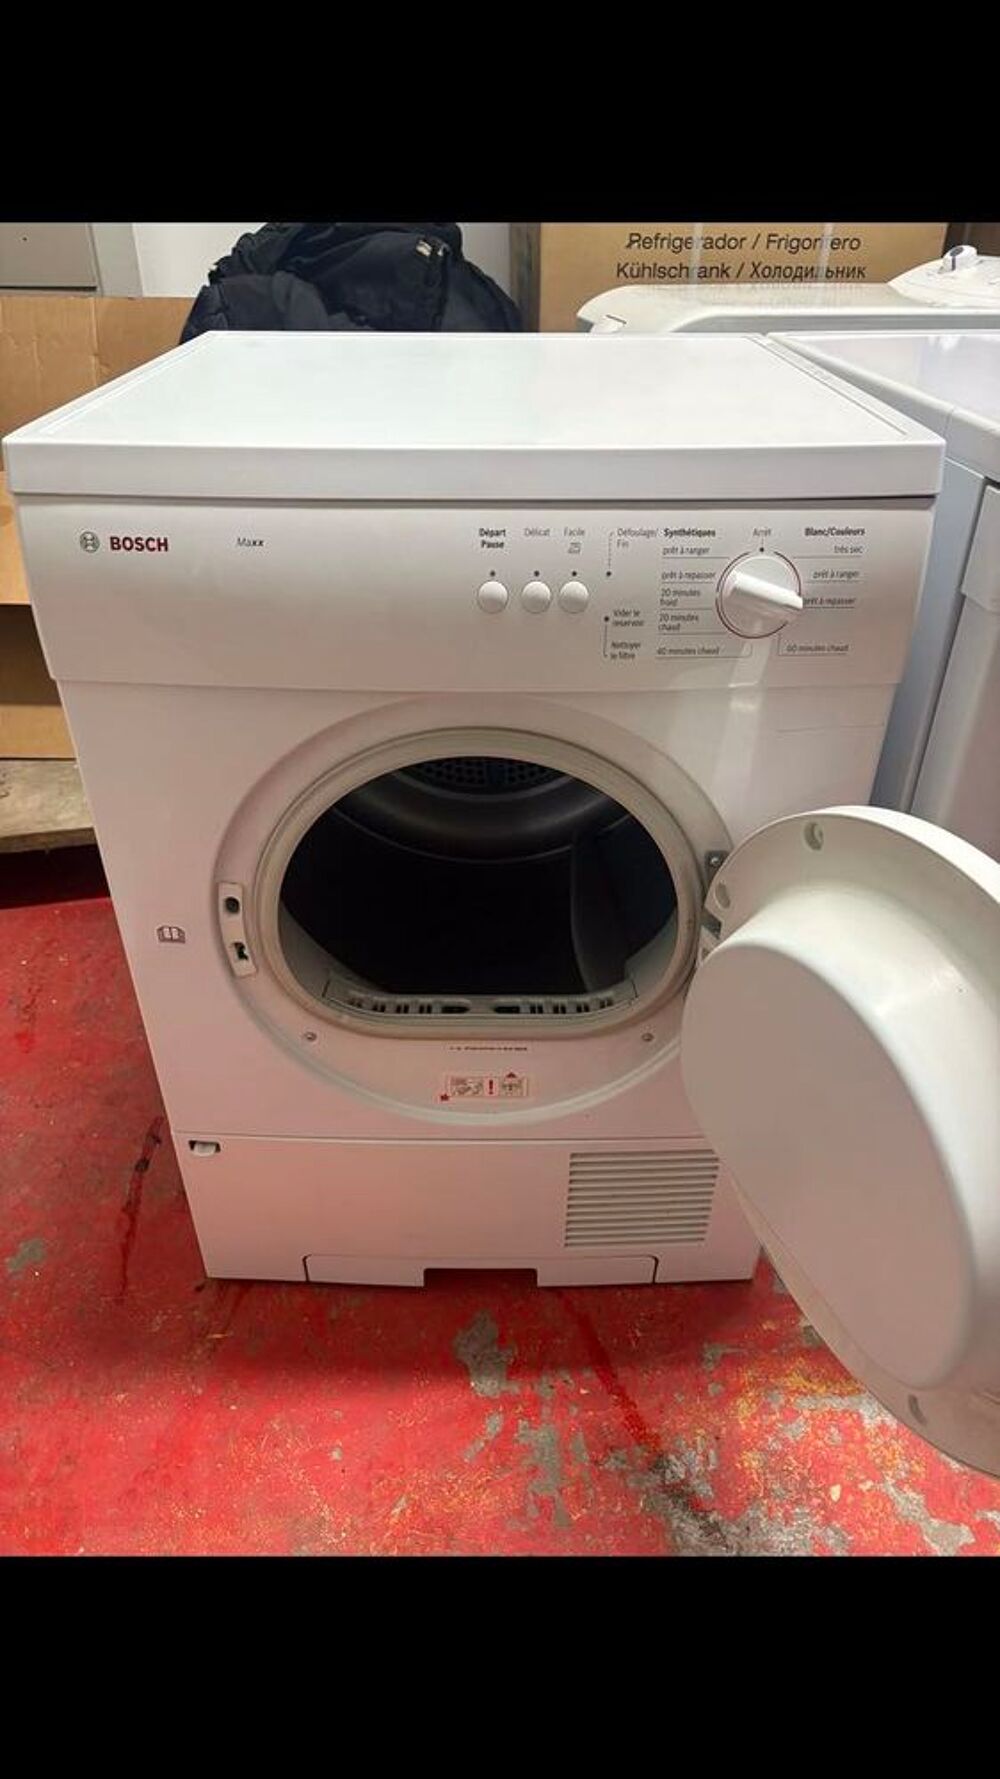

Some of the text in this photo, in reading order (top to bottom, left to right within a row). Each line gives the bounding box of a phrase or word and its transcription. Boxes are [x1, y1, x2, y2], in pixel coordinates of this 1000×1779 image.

[752, 233, 761, 250] /
[766, 233, 861, 254] Frigorero
[616, 262, 731, 279] Kühlschank
[736, 262, 745, 278] /
[479, 527, 506, 539] Départ
[524, 527, 551, 537] Délicat
[564, 527, 585, 537] Facile
[663, 527, 716, 538] Synthétiques
[753, 527, 771, 537] Arrêt
[804, 526, 866, 537] Blanc/Couleurs
[109, 536, 169, 552] BOSCH
[237, 537, 264, 548] Maxx
[481, 540, 505, 549] Pause
[616, 540, 629, 549] Fin
[850, 546, 863, 554] sec
[661, 588, 701, 597] 20 minutes
[659, 613, 669, 622] 20
[658, 623, 681, 631] chaud
